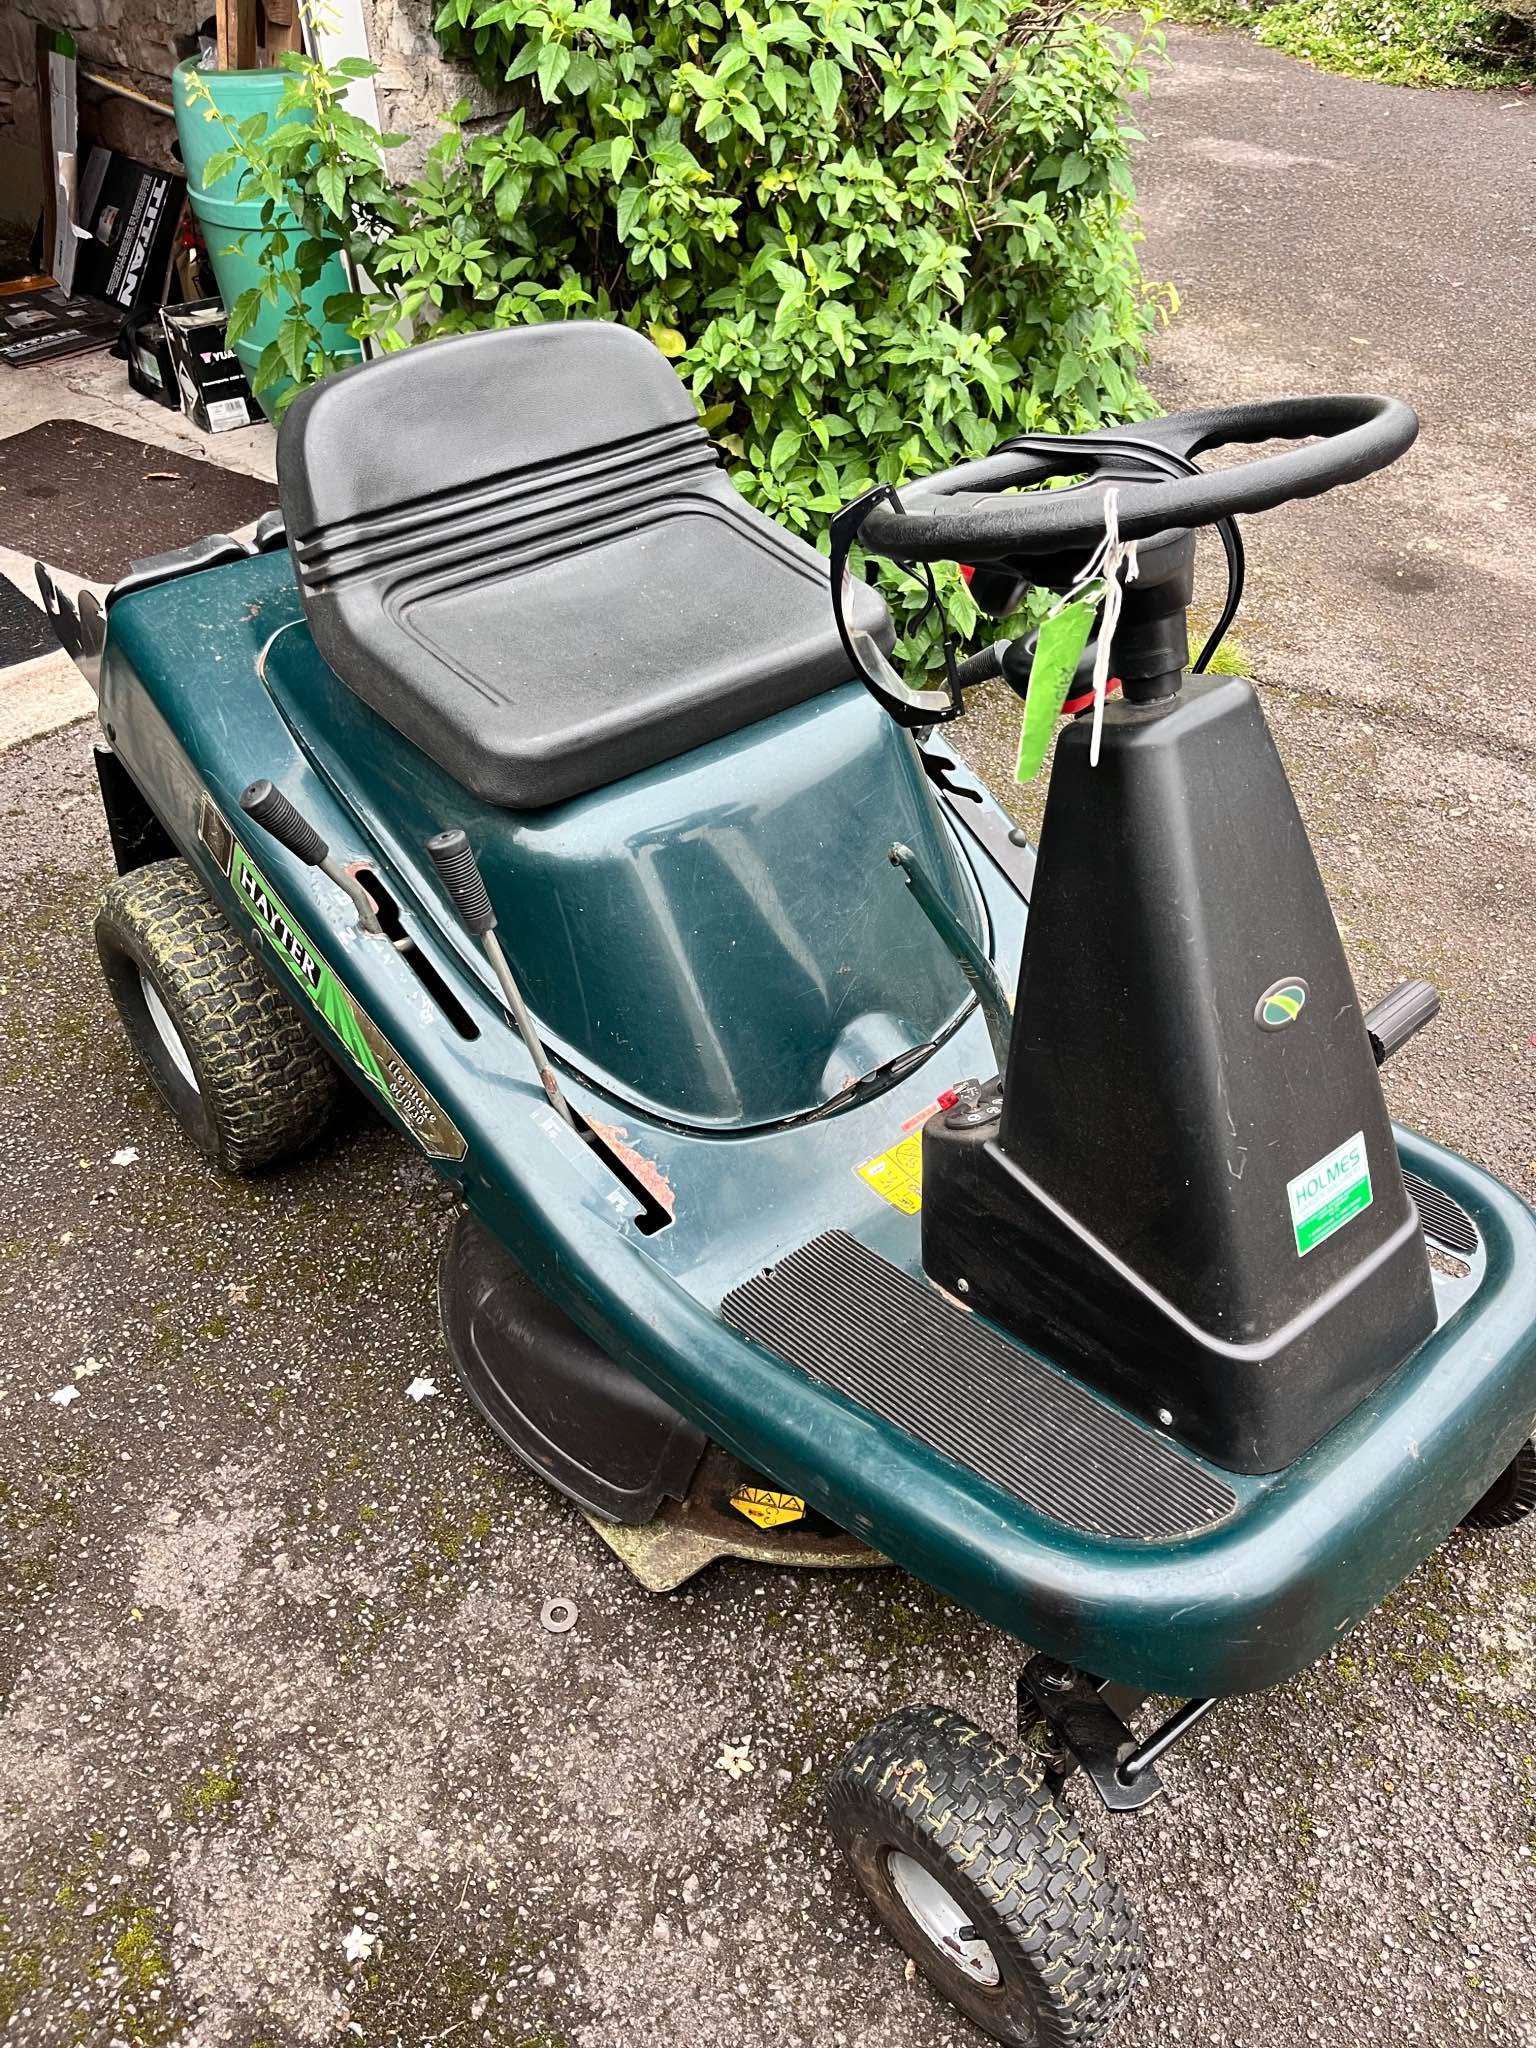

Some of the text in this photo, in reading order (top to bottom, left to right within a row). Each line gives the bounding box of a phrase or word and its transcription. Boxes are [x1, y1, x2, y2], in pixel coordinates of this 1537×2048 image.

[119, 179, 167, 307] TITAN
[212, 349, 237, 362] YUA
[240, 867, 316, 984] HAYTER
[388, 1060, 438, 1123] Heritage
[1296, 1147, 1360, 1206] HOLMES
